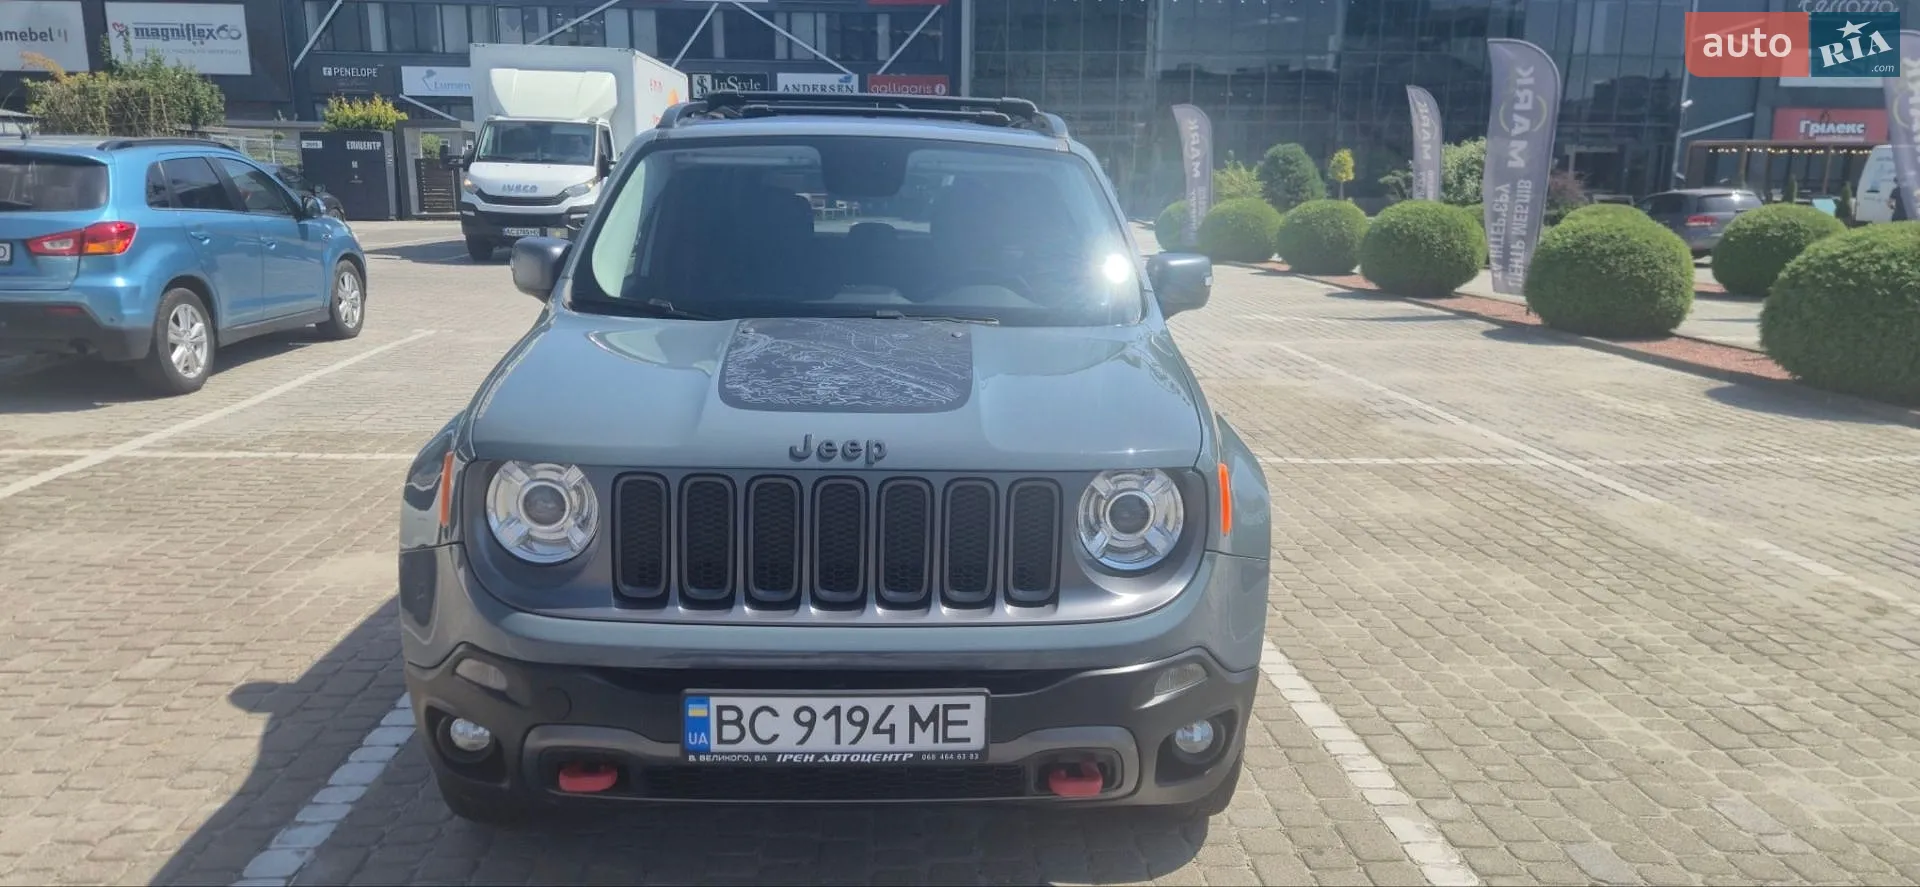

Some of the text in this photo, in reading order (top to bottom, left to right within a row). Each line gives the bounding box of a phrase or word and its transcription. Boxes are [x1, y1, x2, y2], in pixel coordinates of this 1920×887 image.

[0, 26, 54, 42] mebel
[333, 66, 378, 78] PENELOPE
[783, 83, 854, 94] ANDERSEN
[788, 433, 888, 465] Jeep
[716, 703, 972, 746] BC 9194 ME
[688, 731, 708, 746] UA
[817, 752, 914, 763] АВТОЦЕНТР
